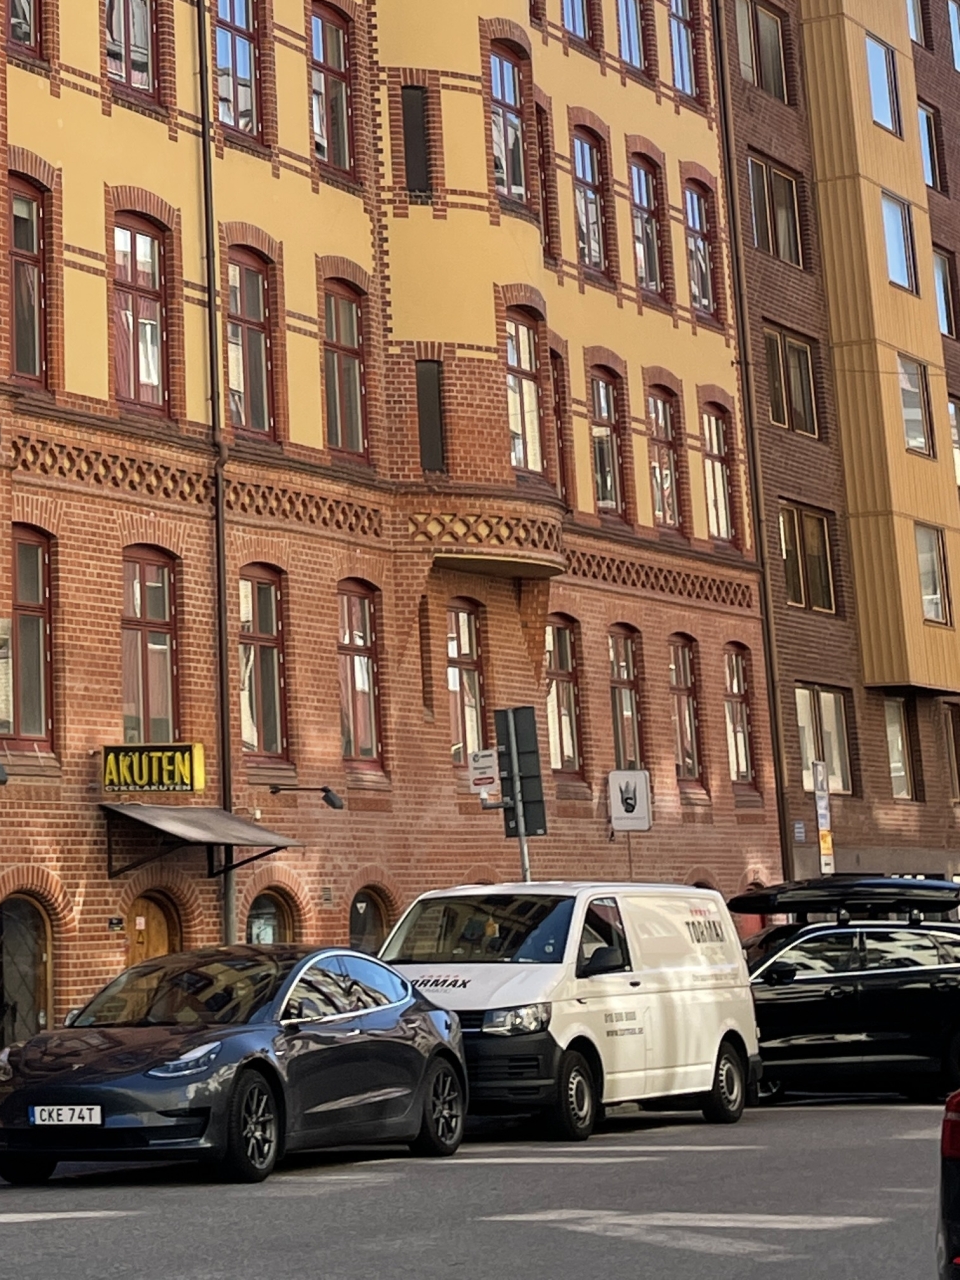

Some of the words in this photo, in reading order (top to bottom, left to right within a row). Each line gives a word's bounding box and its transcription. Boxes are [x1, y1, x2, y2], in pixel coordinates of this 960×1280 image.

[105, 751, 191, 786] AKUTEN
[105, 784, 192, 792] CYKELAKUTEN
[411, 978, 472, 989] ORMAX
[39, 1107, 64, 1123] CKE
[67, 1106, 95, 1123] 74T
